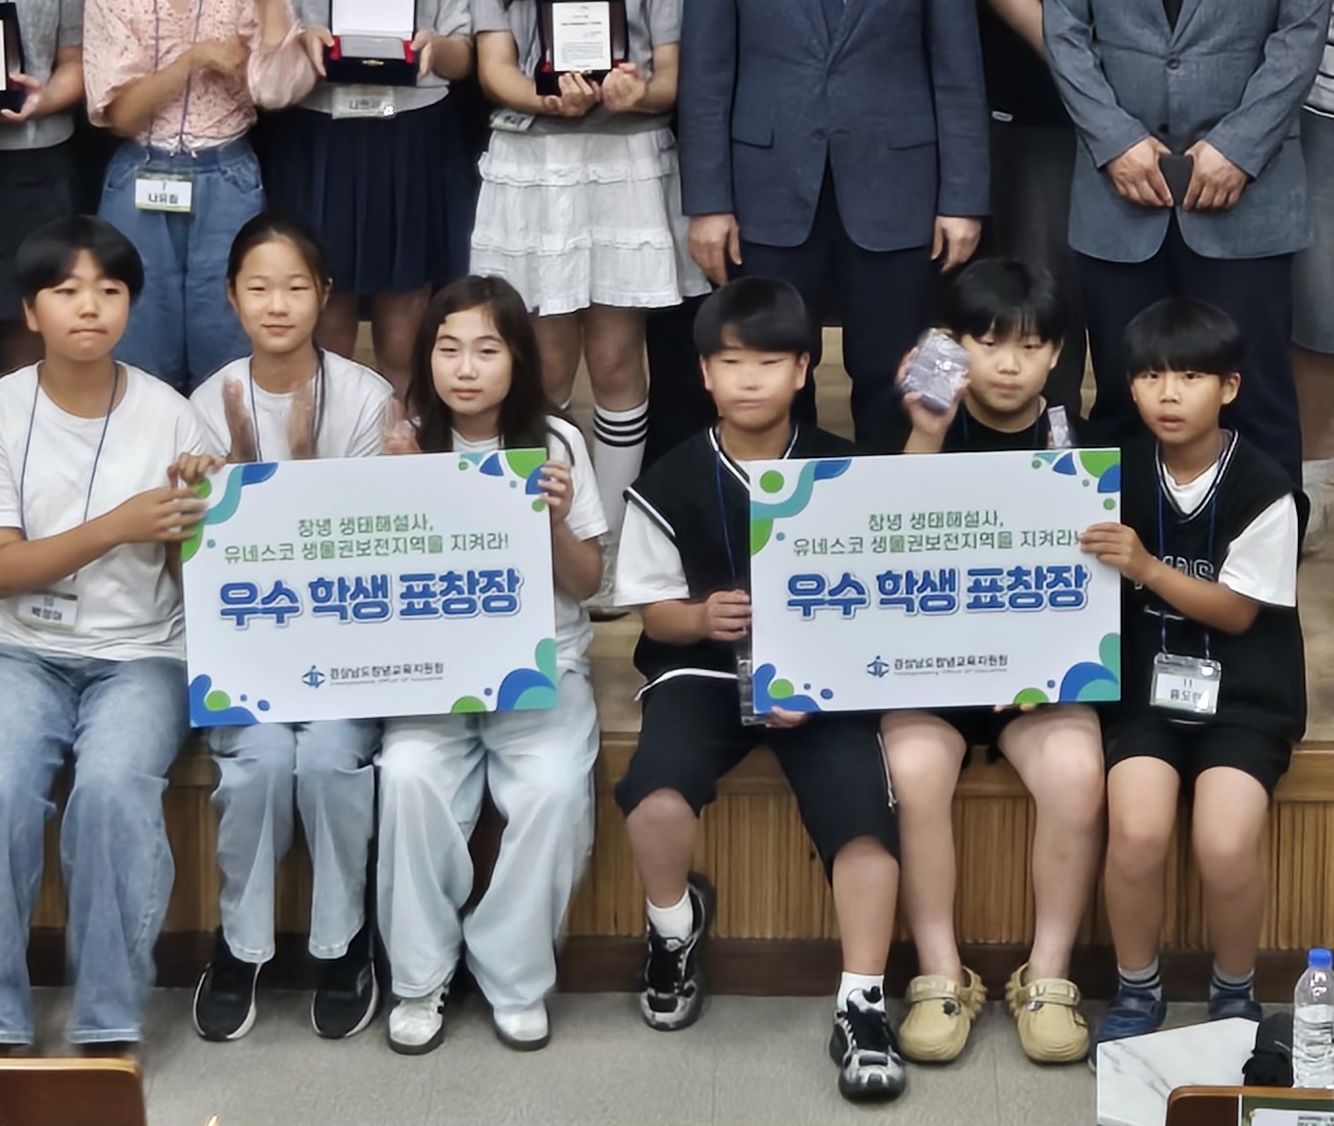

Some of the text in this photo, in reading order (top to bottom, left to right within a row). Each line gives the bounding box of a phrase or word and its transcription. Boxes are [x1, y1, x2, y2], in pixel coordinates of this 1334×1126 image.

[298, 518, 332, 538] 창녕
[868, 512, 902, 532] 창녕
[224, 543, 295, 564] 유네스코
[793, 537, 864, 556] 유네스코
[220, 568, 520, 626] 우수 학생 표창장
[787, 564, 1088, 618] 우수 학생 표창장
